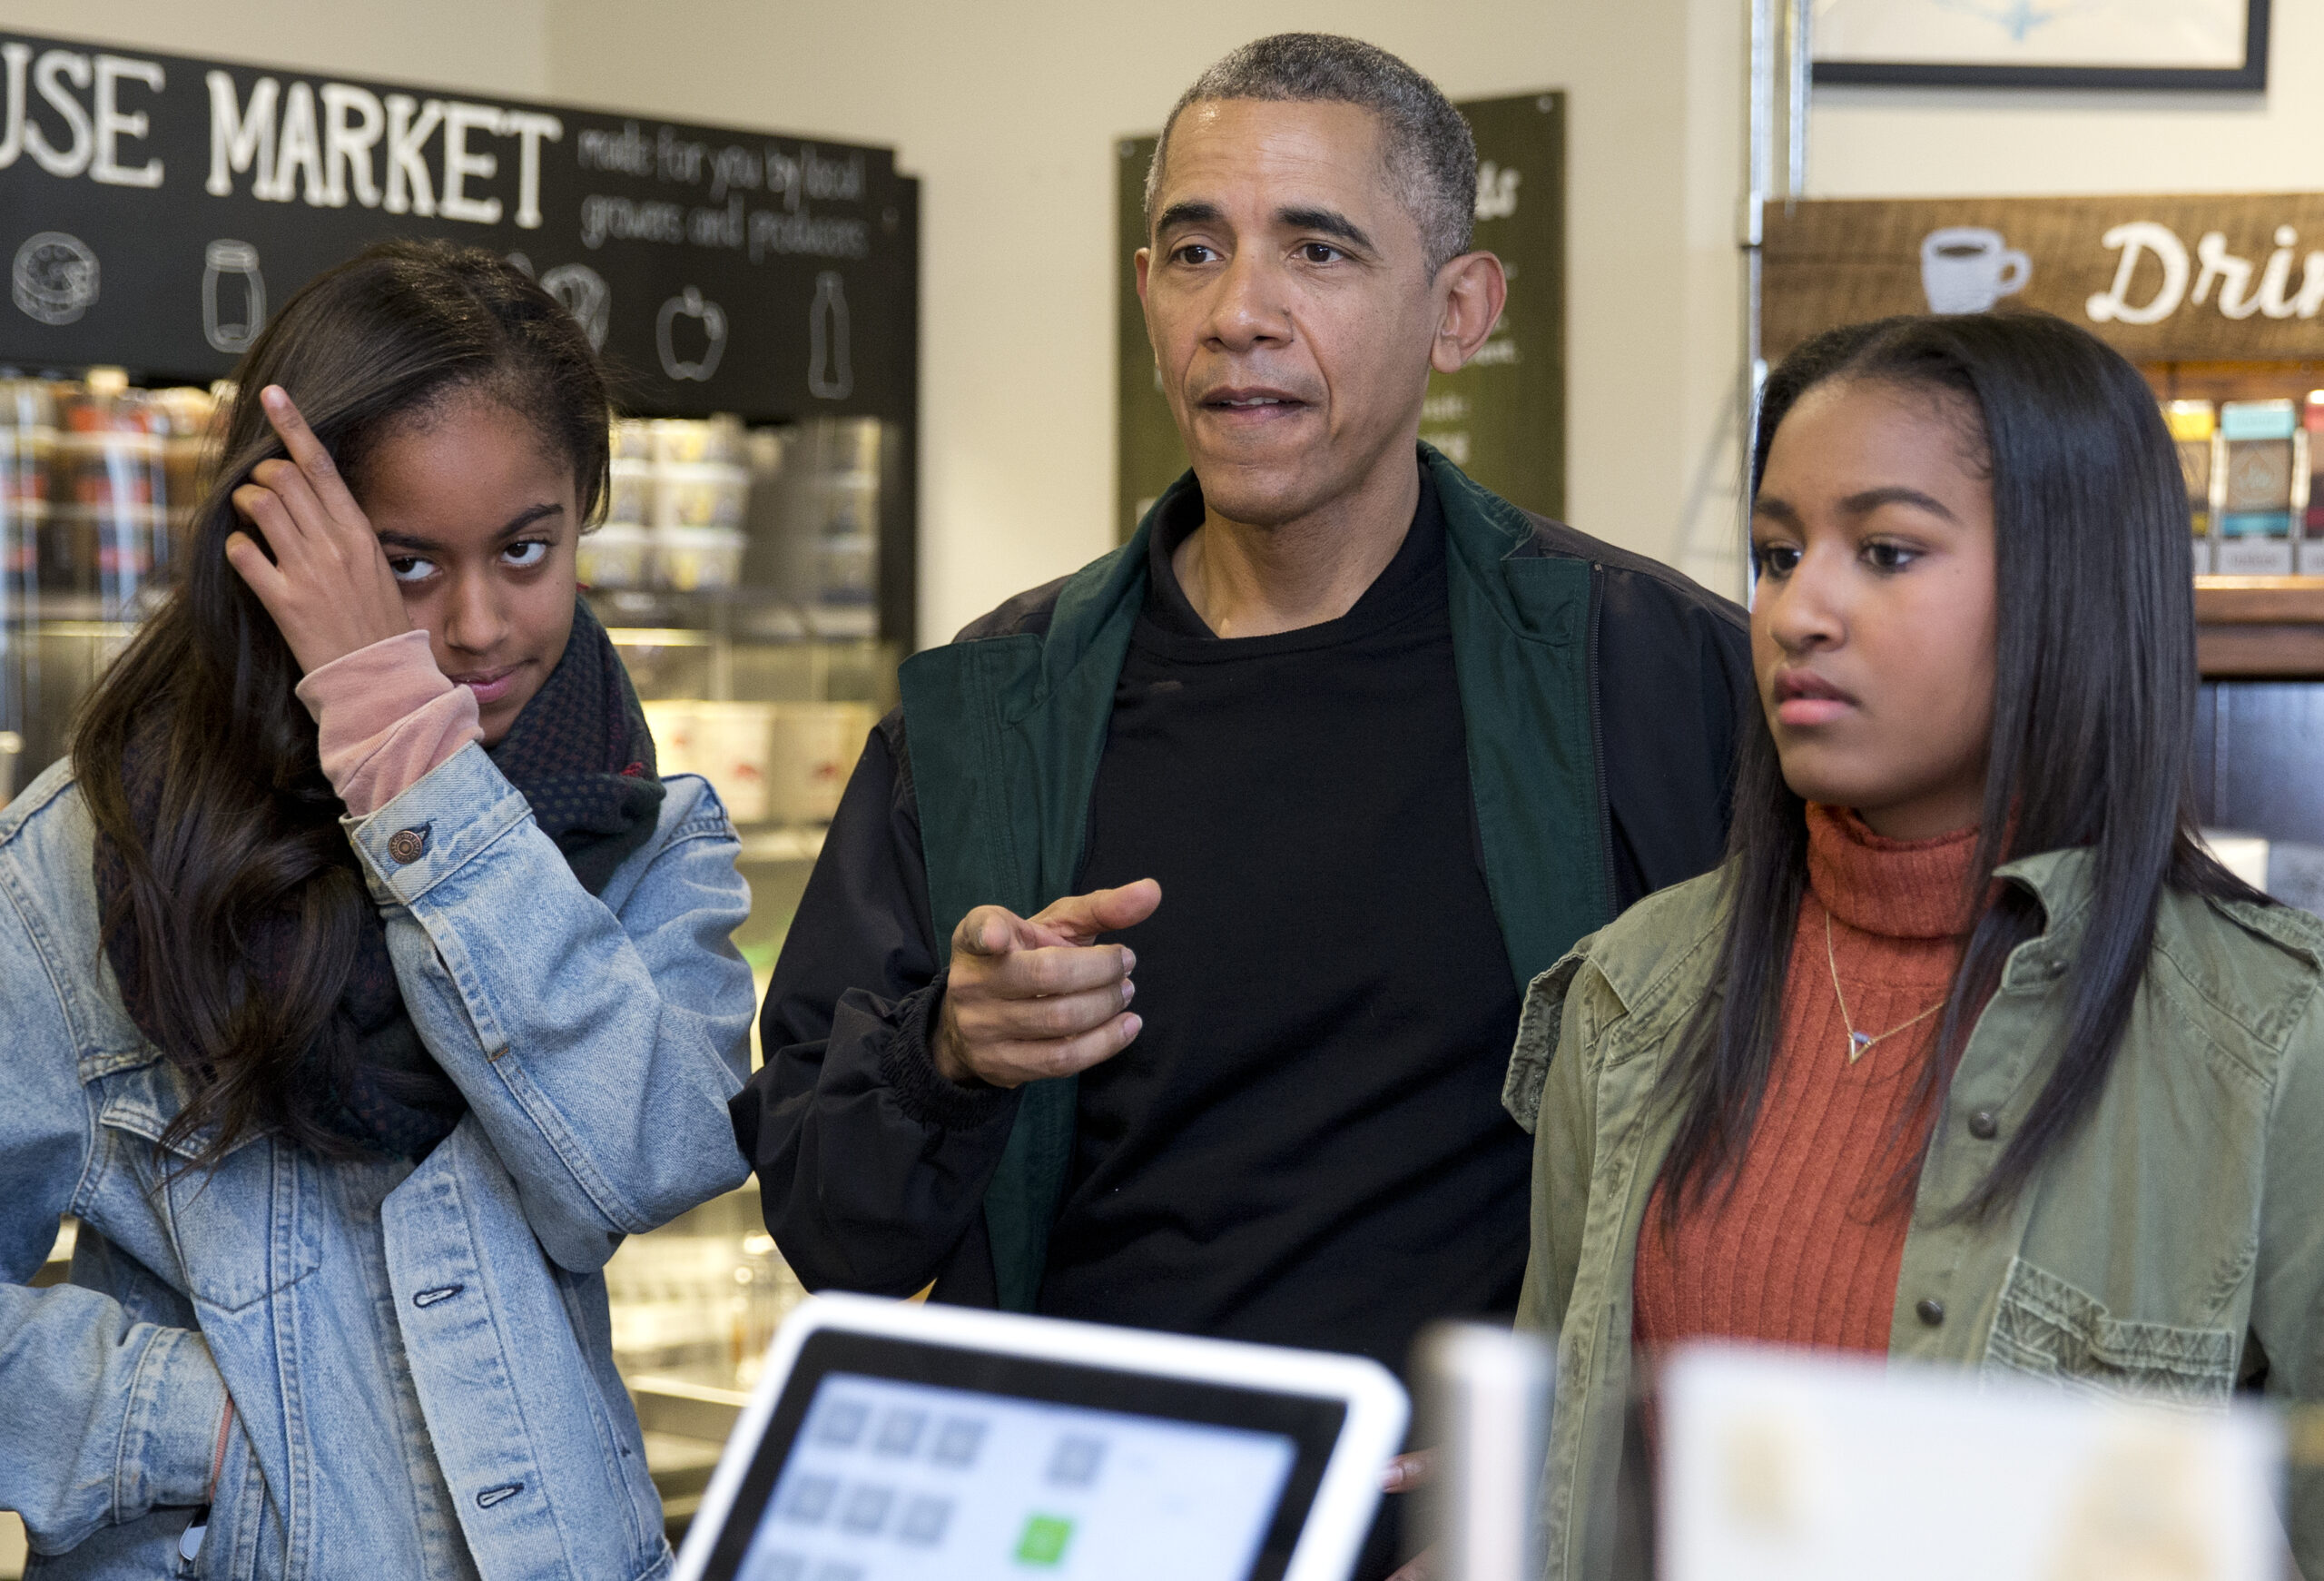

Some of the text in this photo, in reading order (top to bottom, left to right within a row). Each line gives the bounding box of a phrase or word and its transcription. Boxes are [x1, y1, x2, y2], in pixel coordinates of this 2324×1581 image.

[206, 70, 563, 229] MARKET
[657, 124, 707, 183] for
[685, 191, 744, 249] and
